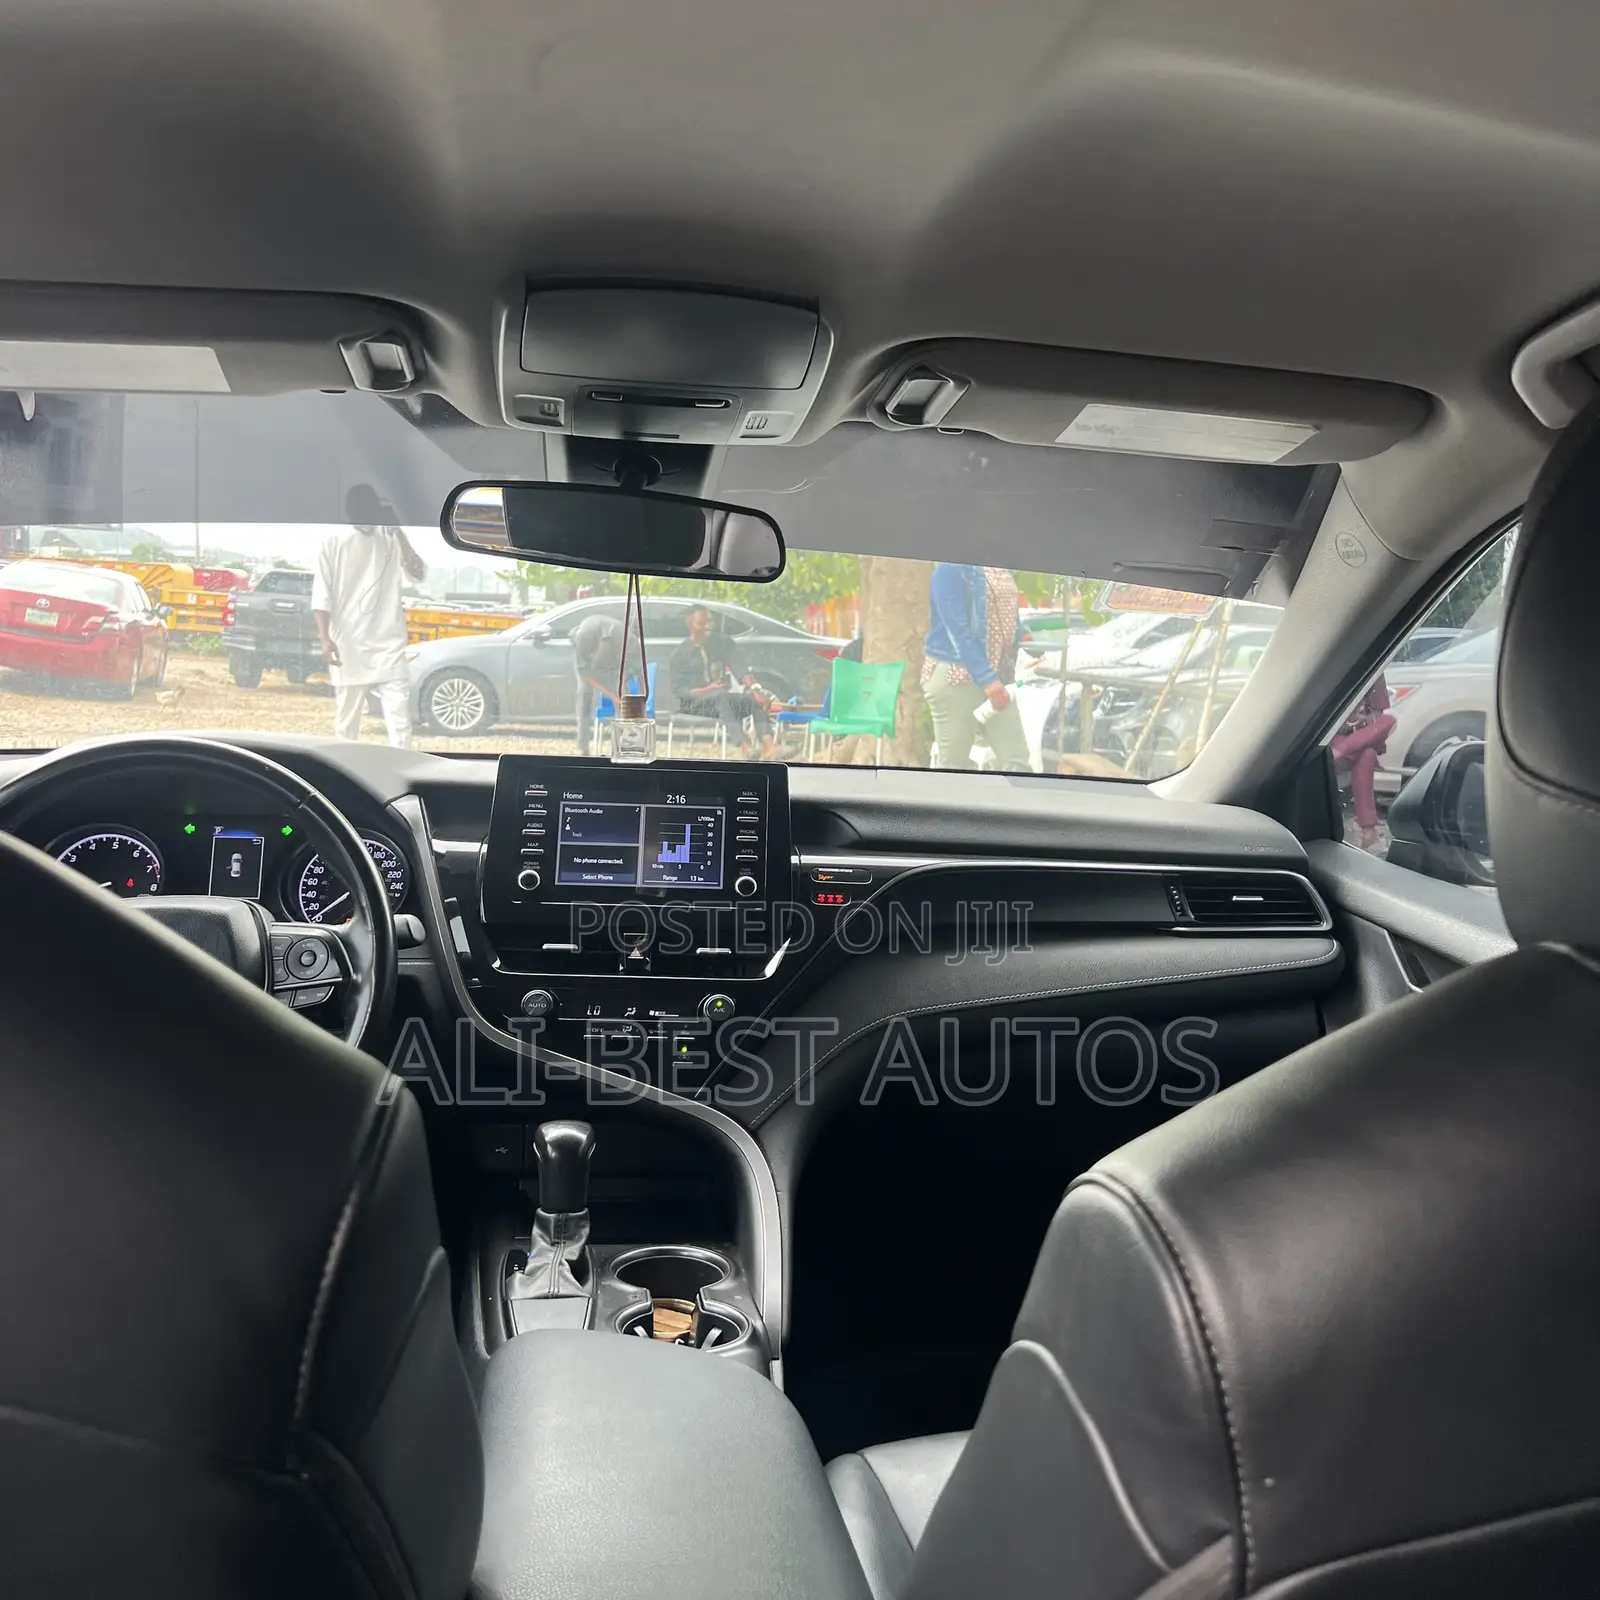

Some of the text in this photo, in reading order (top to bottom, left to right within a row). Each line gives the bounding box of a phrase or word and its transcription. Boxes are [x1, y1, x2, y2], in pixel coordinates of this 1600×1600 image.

[563, 791, 584, 800] Home
[666, 794, 687, 804] 2:16
[564, 806, 588, 814] Bluetooth
[89, 842, 97, 851] 4
[111, 841, 119, 850] 5
[132, 850, 141, 858] 6
[373, 851, 385, 859] 180
[69, 854, 77, 863] 3
[381, 861, 396, 869] 200
[146, 866, 153, 874] 7
[313, 866, 324, 874] 80
[387, 871, 401, 879] 220
[662, 874, 678, 882] Range
[307, 878, 318, 886] 60
[150, 883, 158, 892] 8
[586, 1005, 601, 1016] LO
